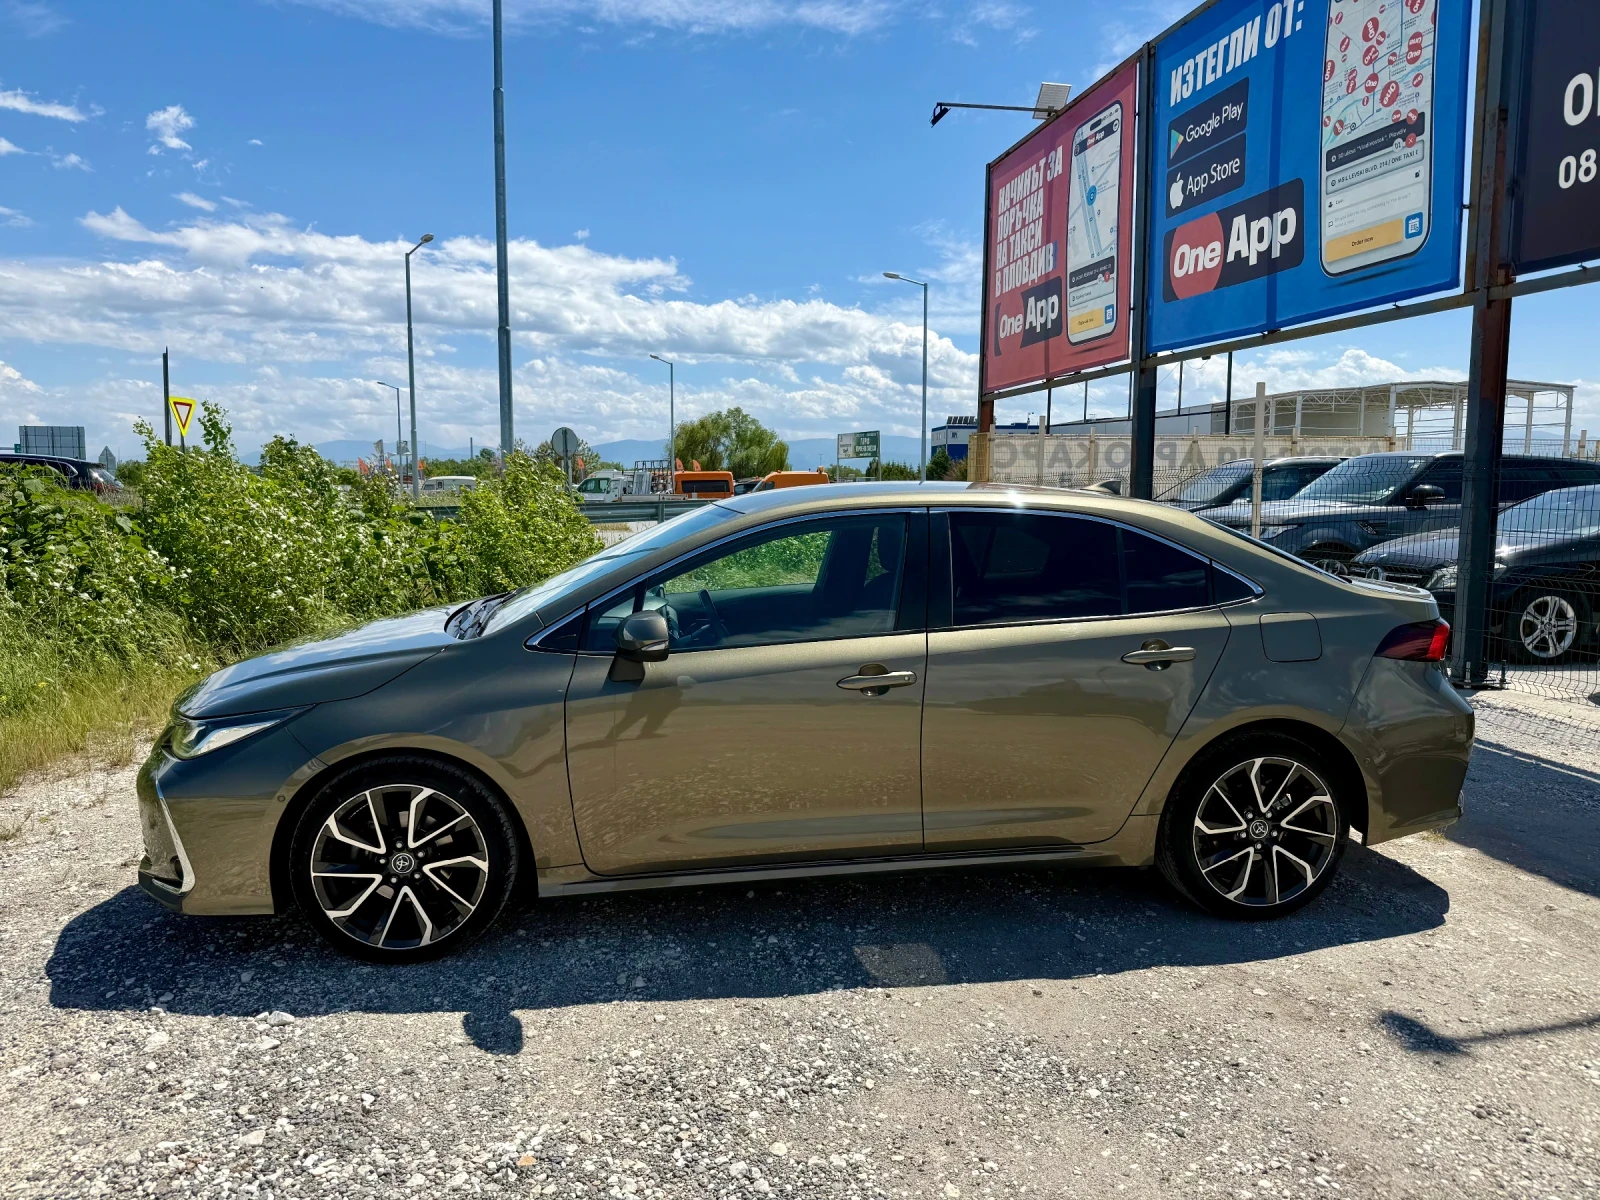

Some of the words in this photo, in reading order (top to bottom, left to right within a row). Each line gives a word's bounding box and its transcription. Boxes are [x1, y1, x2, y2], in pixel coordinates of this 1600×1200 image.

[1170, 15, 1262, 108] ИЗТЕГЛИ
[1264, 0, 1304, 49] ОТ:
[1365, 79, 1378, 88] One
[1563, 66, 1600, 126] O
[1185, 113, 1221, 143] Google
[1221, 102, 1245, 125] Play
[1186, 175, 1208, 197] App
[1210, 157, 1241, 184] Store
[1391, 155, 1402, 164] ONE
[1403, 151, 1414, 160] TAXI
[1558, 148, 1597, 189] 08
[998, 156, 1046, 216] НАЧИНЪТ
[1047, 144, 1063, 182] ЗА
[997, 187, 1044, 241] ПОРЪЧКА
[995, 241, 1007, 270] НА
[1009, 217, 1043, 263] ТАКСИ
[1173, 240, 1222, 278] One
[1226, 207, 1297, 266] App
[995, 270, 1002, 298] В
[1000, 313, 1023, 338] One
[1025, 294, 1059, 333] App
